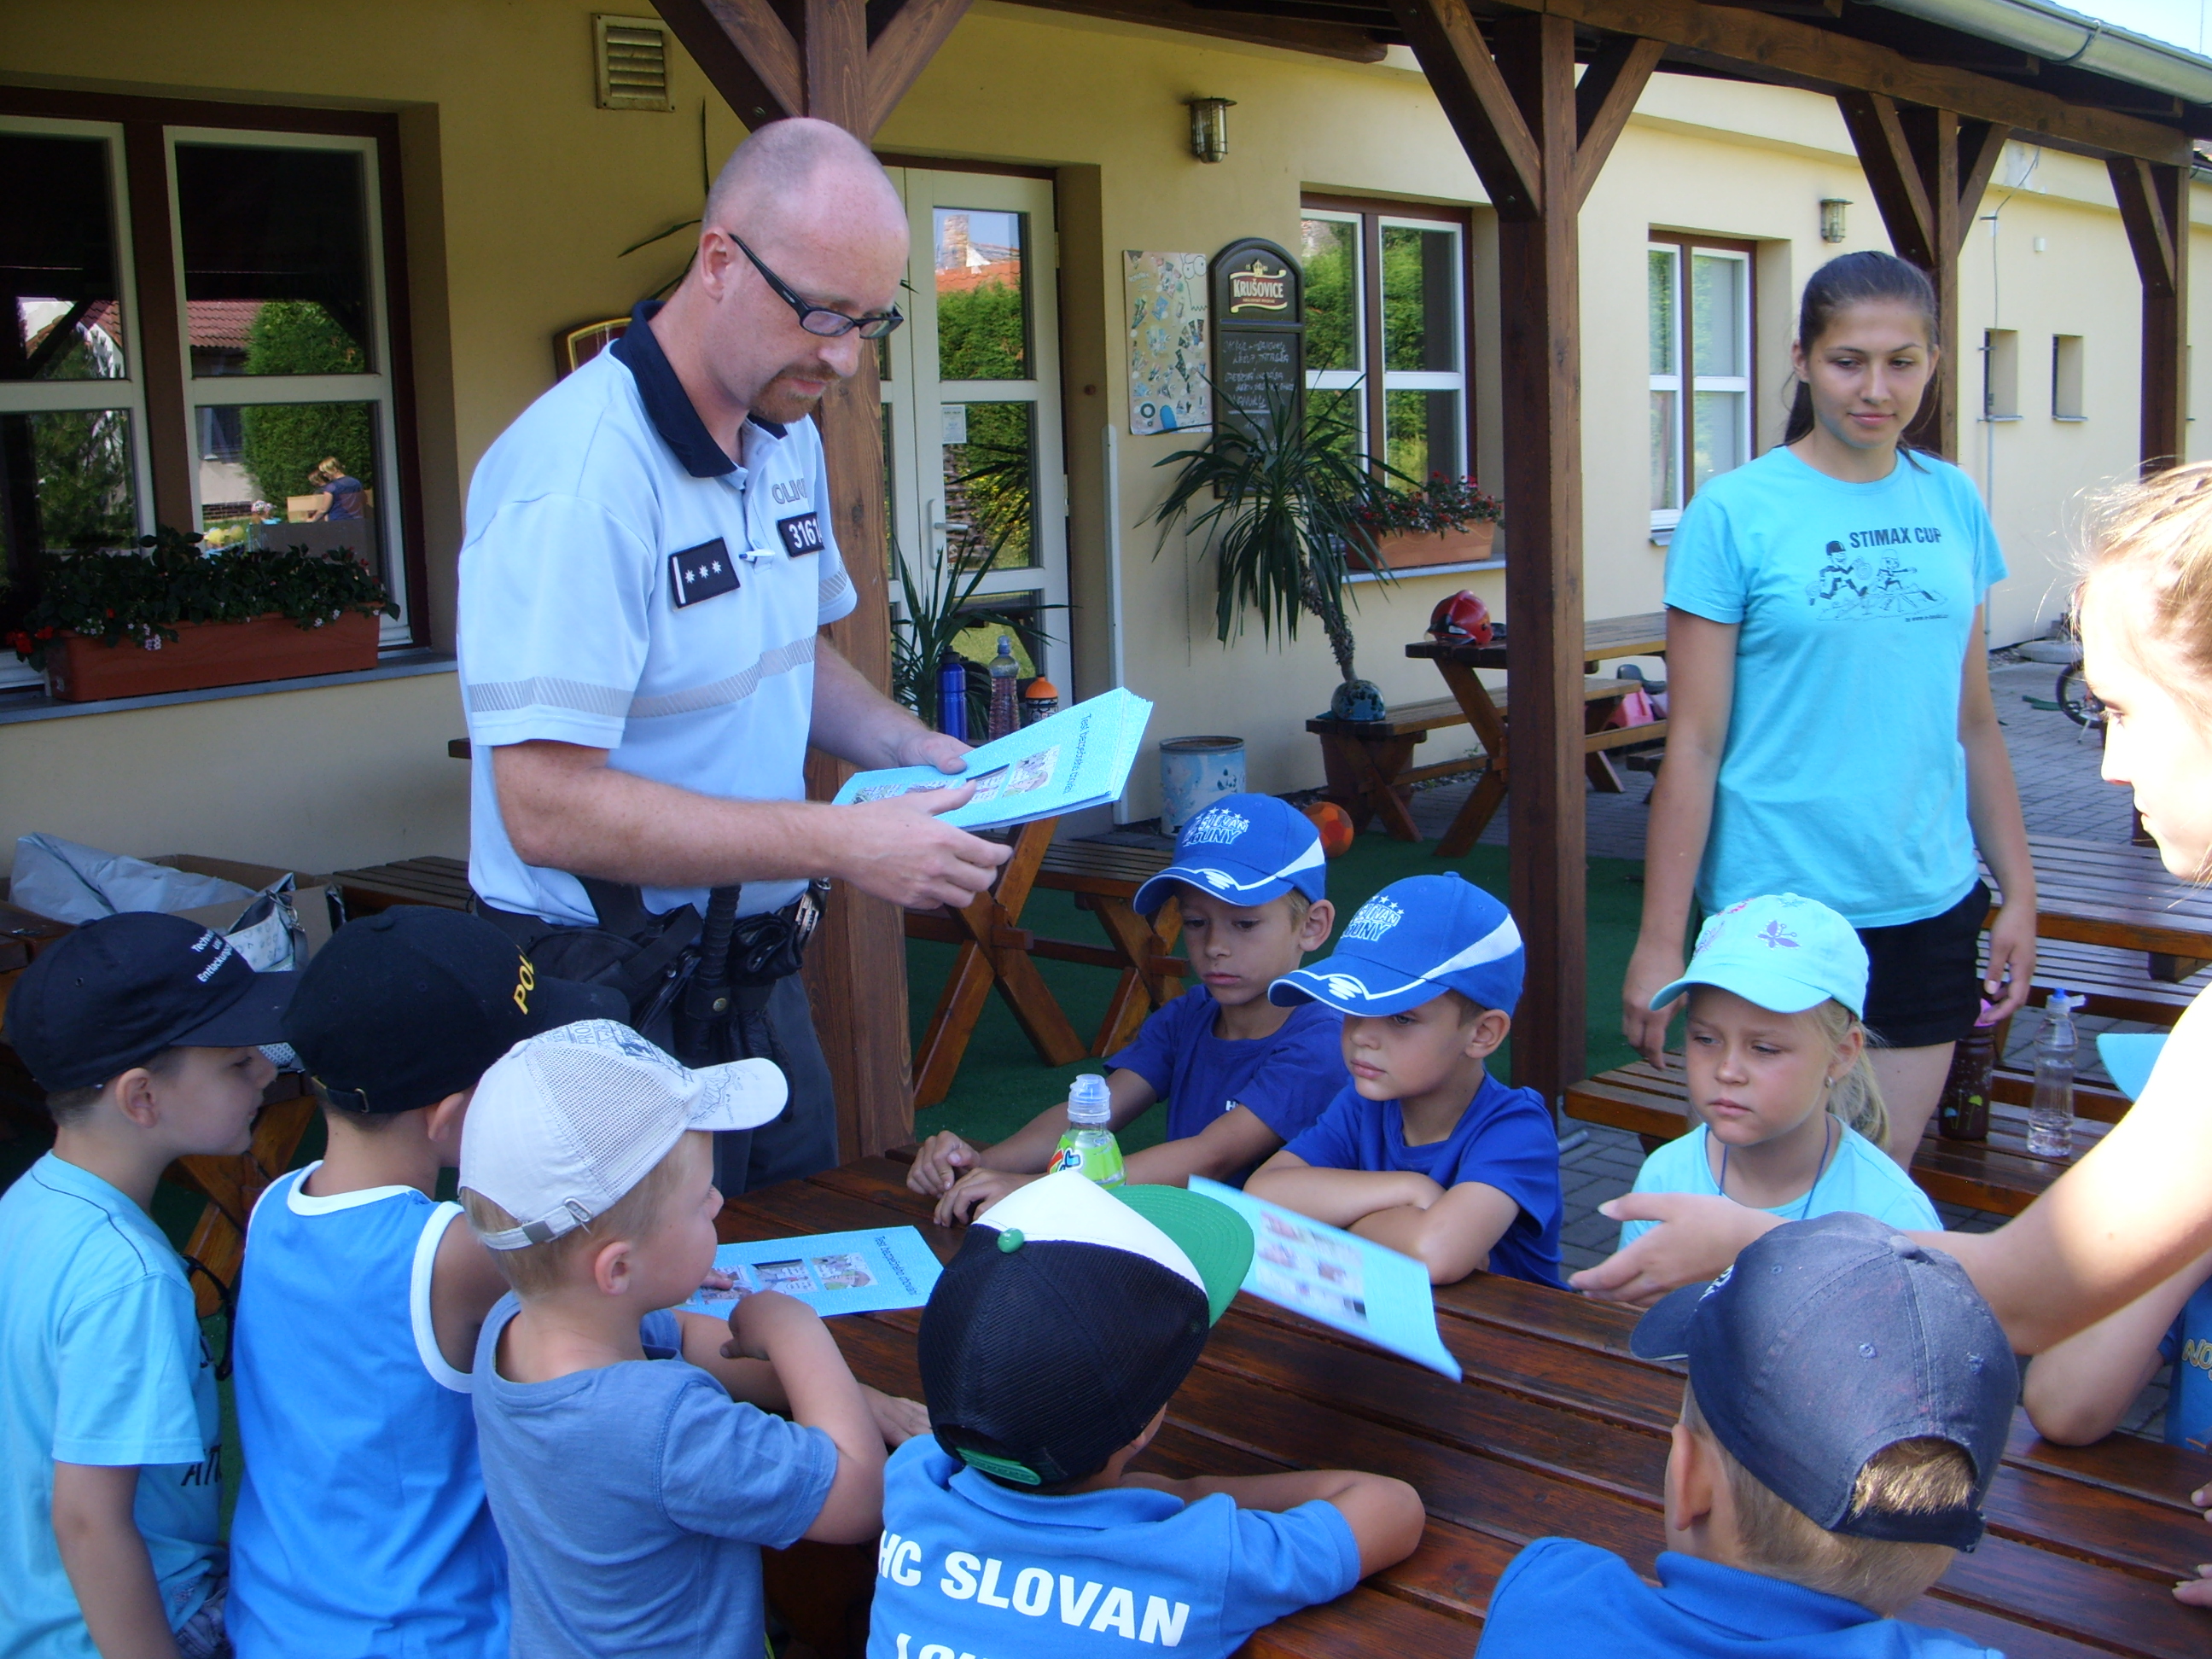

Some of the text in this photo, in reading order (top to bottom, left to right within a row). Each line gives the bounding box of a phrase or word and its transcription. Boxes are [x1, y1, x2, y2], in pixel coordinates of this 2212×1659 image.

[1233, 277, 1284, 298] KRUŠOVICE
[1849, 527, 1941, 549] STIMAX CUP
[1225, 1100, 1239, 1111] H
[878, 1529, 1190, 1648] HC SLOVAN
